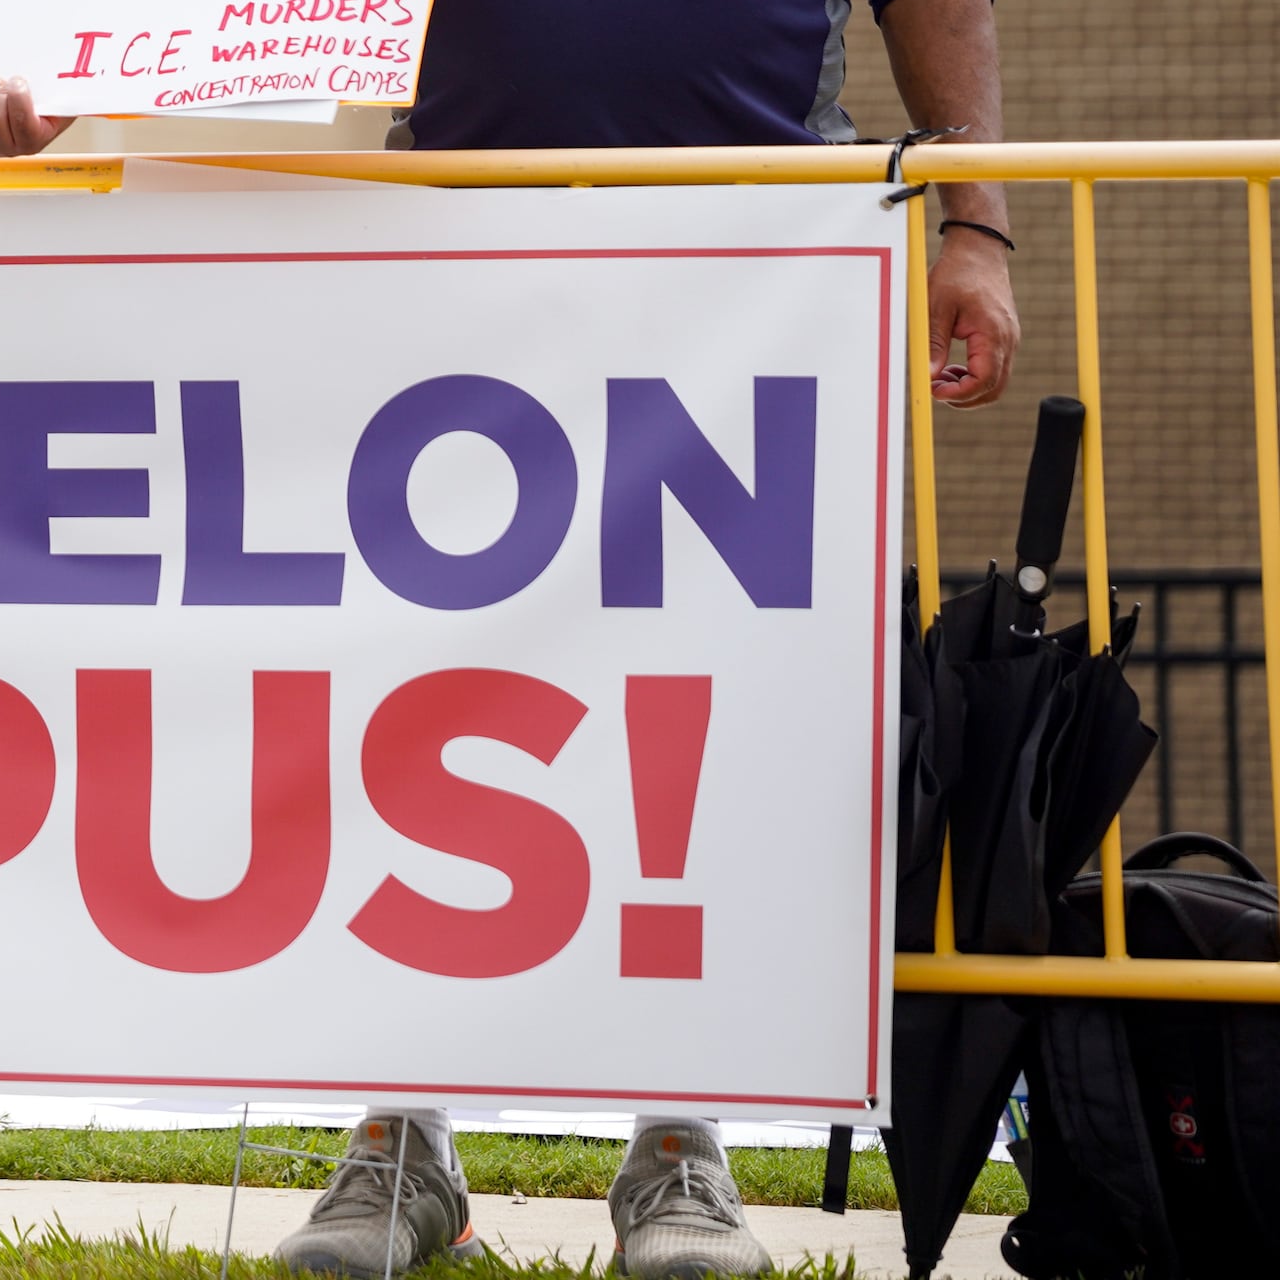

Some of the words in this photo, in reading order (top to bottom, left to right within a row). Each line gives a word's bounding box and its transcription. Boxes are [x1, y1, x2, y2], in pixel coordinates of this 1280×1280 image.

[211, 34, 412, 64] WAREHOUSES
[153, 66, 321, 107] CONCENTRATION
[327, 64, 409, 96] CAMPS
